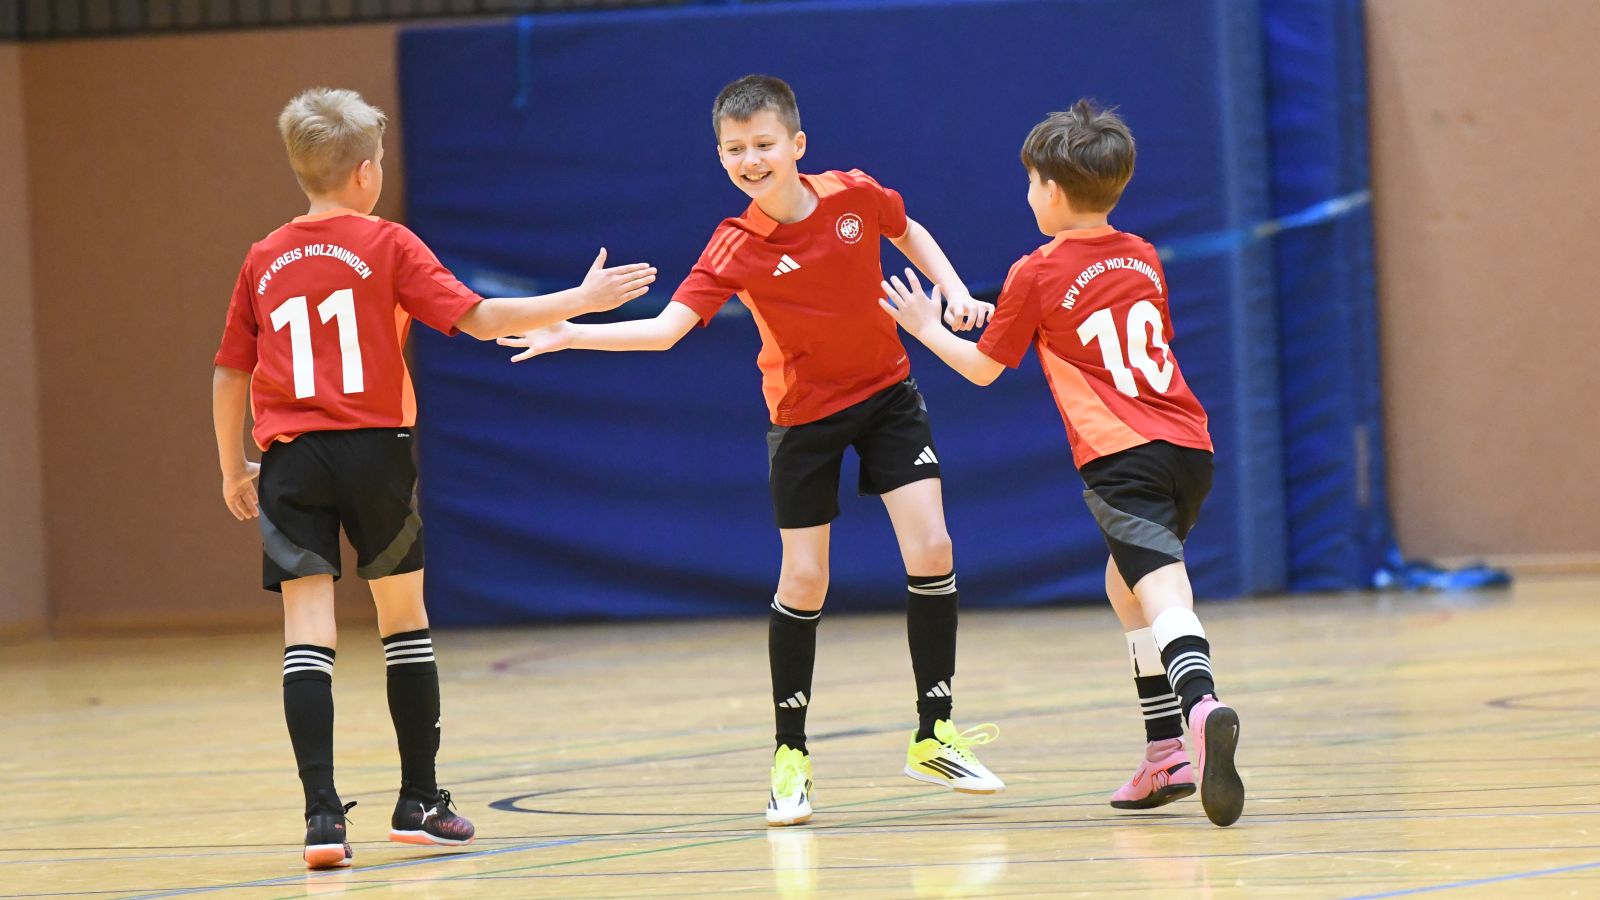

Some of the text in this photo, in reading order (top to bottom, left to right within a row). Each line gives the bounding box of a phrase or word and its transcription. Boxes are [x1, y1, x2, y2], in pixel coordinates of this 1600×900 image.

[257, 244, 372, 296] NFV KREIS HOLZMINDEN
[1061, 285, 1080, 309] NFV
[1075, 262, 1105, 288] KREIS
[269, 288, 364, 399] 11
[1076, 300, 1174, 398] 10
